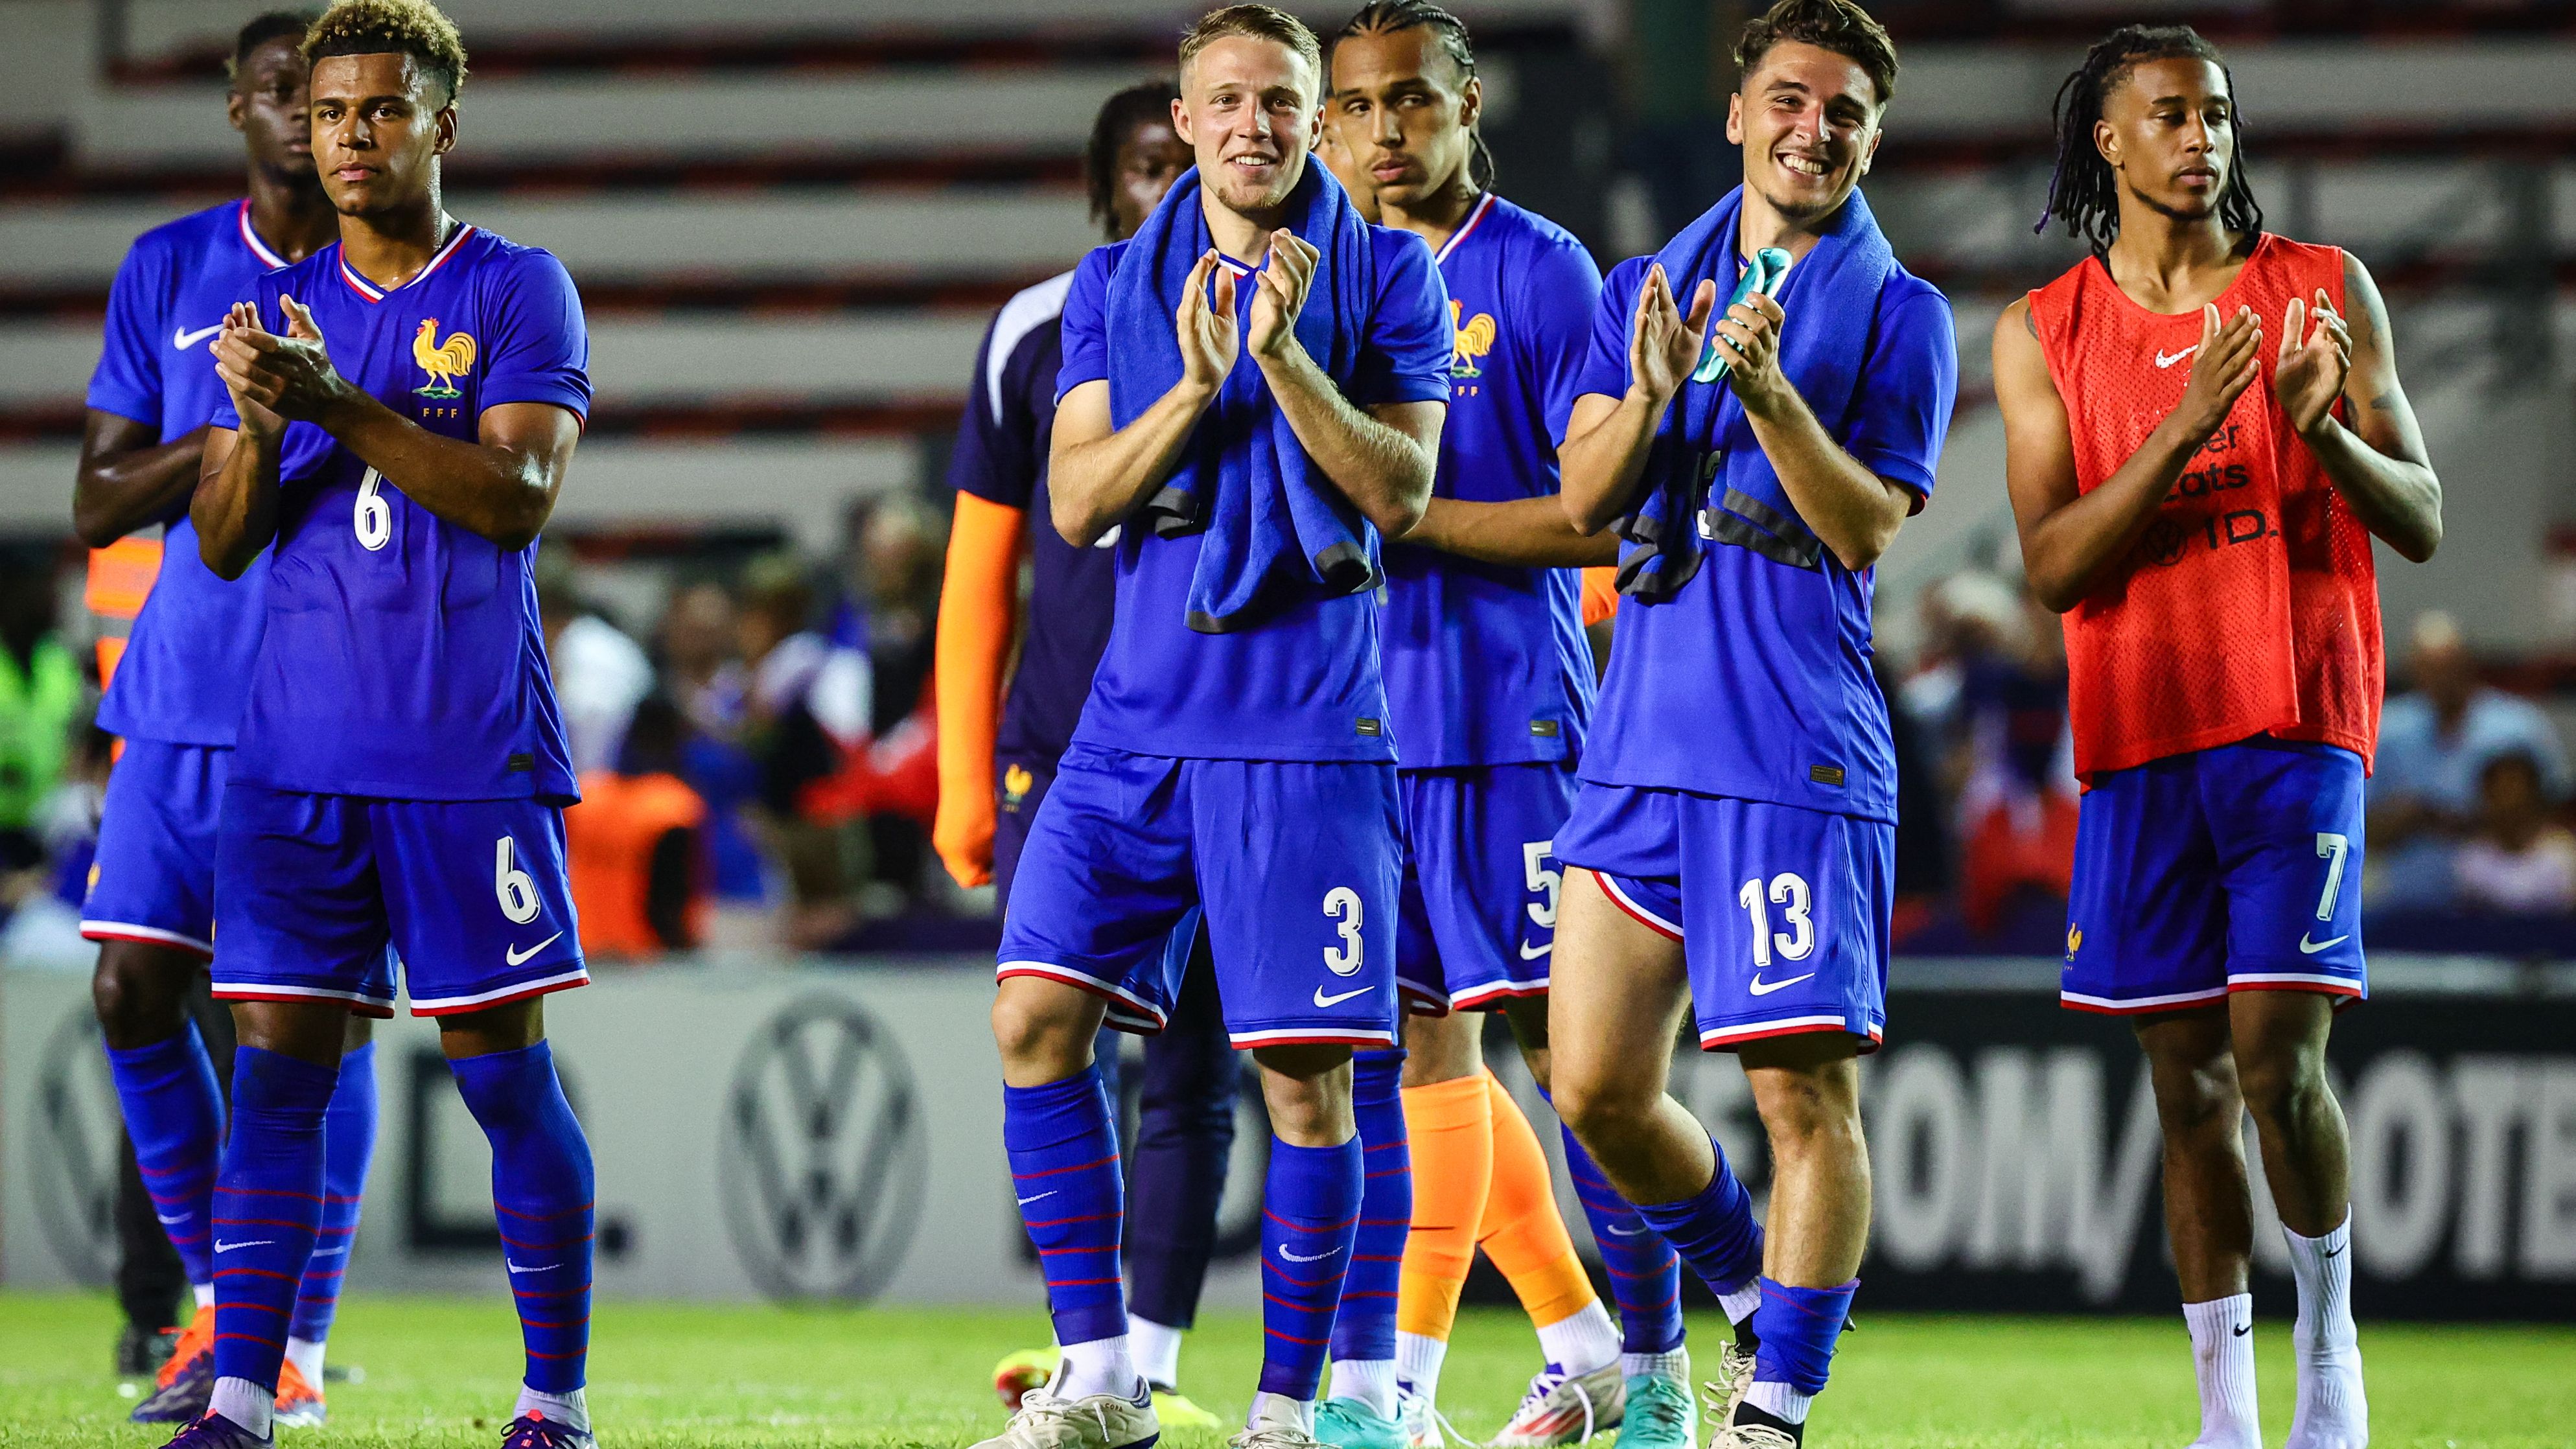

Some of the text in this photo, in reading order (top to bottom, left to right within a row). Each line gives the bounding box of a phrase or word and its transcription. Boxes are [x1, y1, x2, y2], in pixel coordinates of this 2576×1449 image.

[354, 465, 391, 551] 6
[2164, 462, 2250, 504] ats
[496, 835, 541, 925] 6
[1523, 840, 1562, 929] 5
[1739, 872, 1815, 967] 13
[2316, 832, 2349, 922] 7
[1323, 887, 1363, 977] 3
